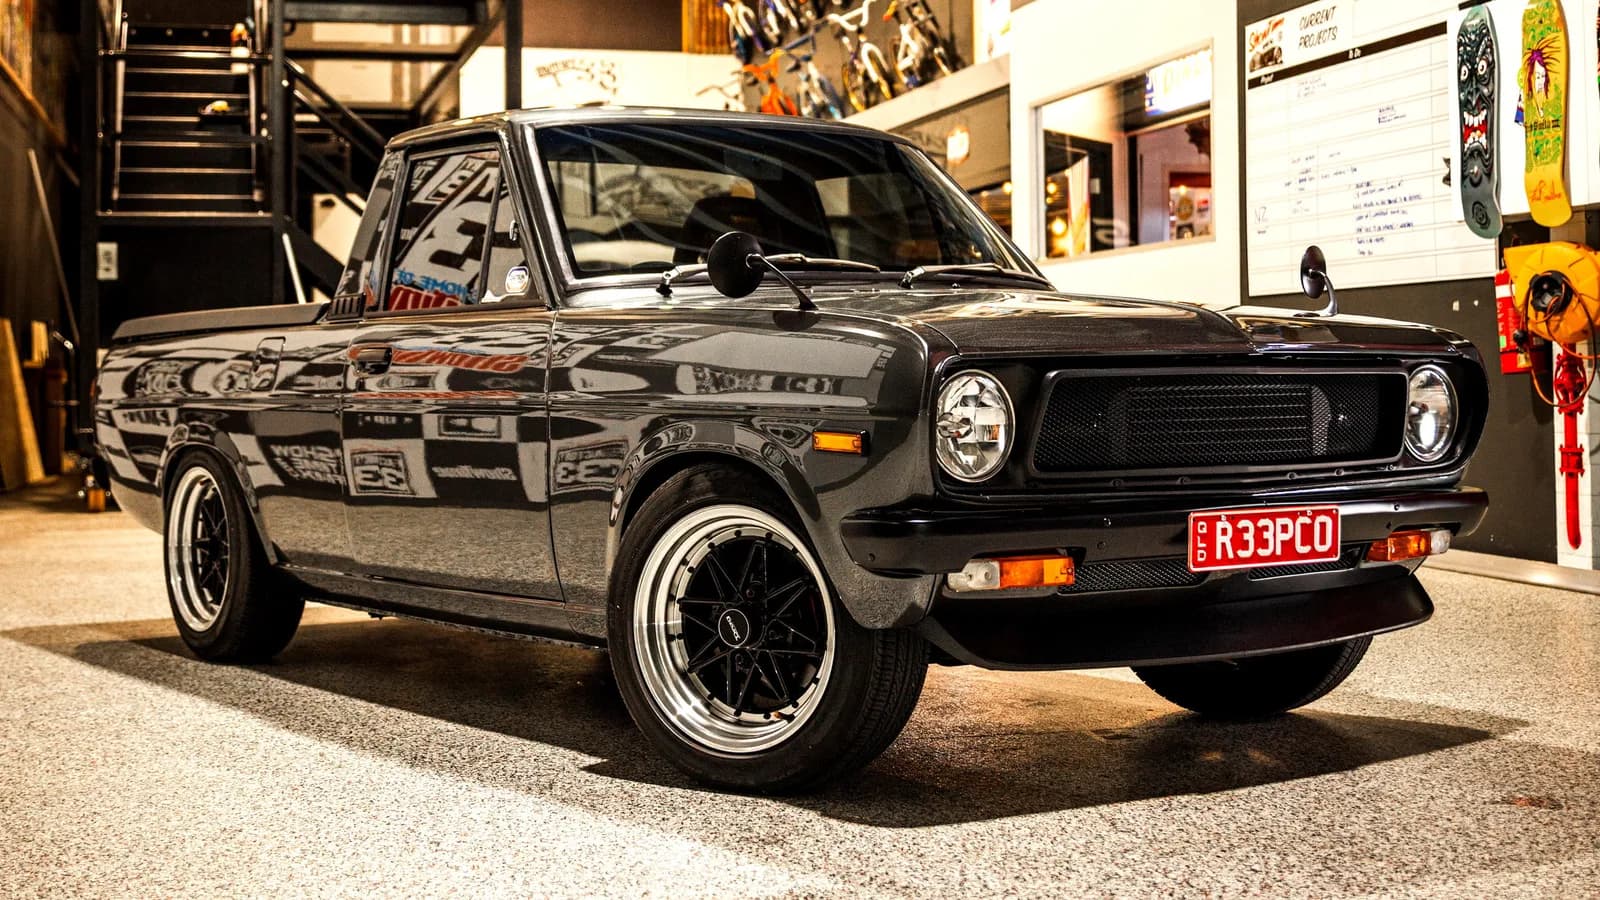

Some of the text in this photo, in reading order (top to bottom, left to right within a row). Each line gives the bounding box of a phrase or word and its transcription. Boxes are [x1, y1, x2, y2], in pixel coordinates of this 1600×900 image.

[1299, 6, 1337, 31] CURRENT
[1298, 26, 1338, 50] PROJECTS
[1197, 521, 1208, 562] QLD
[1215, 515, 1333, 560] R33PCO
